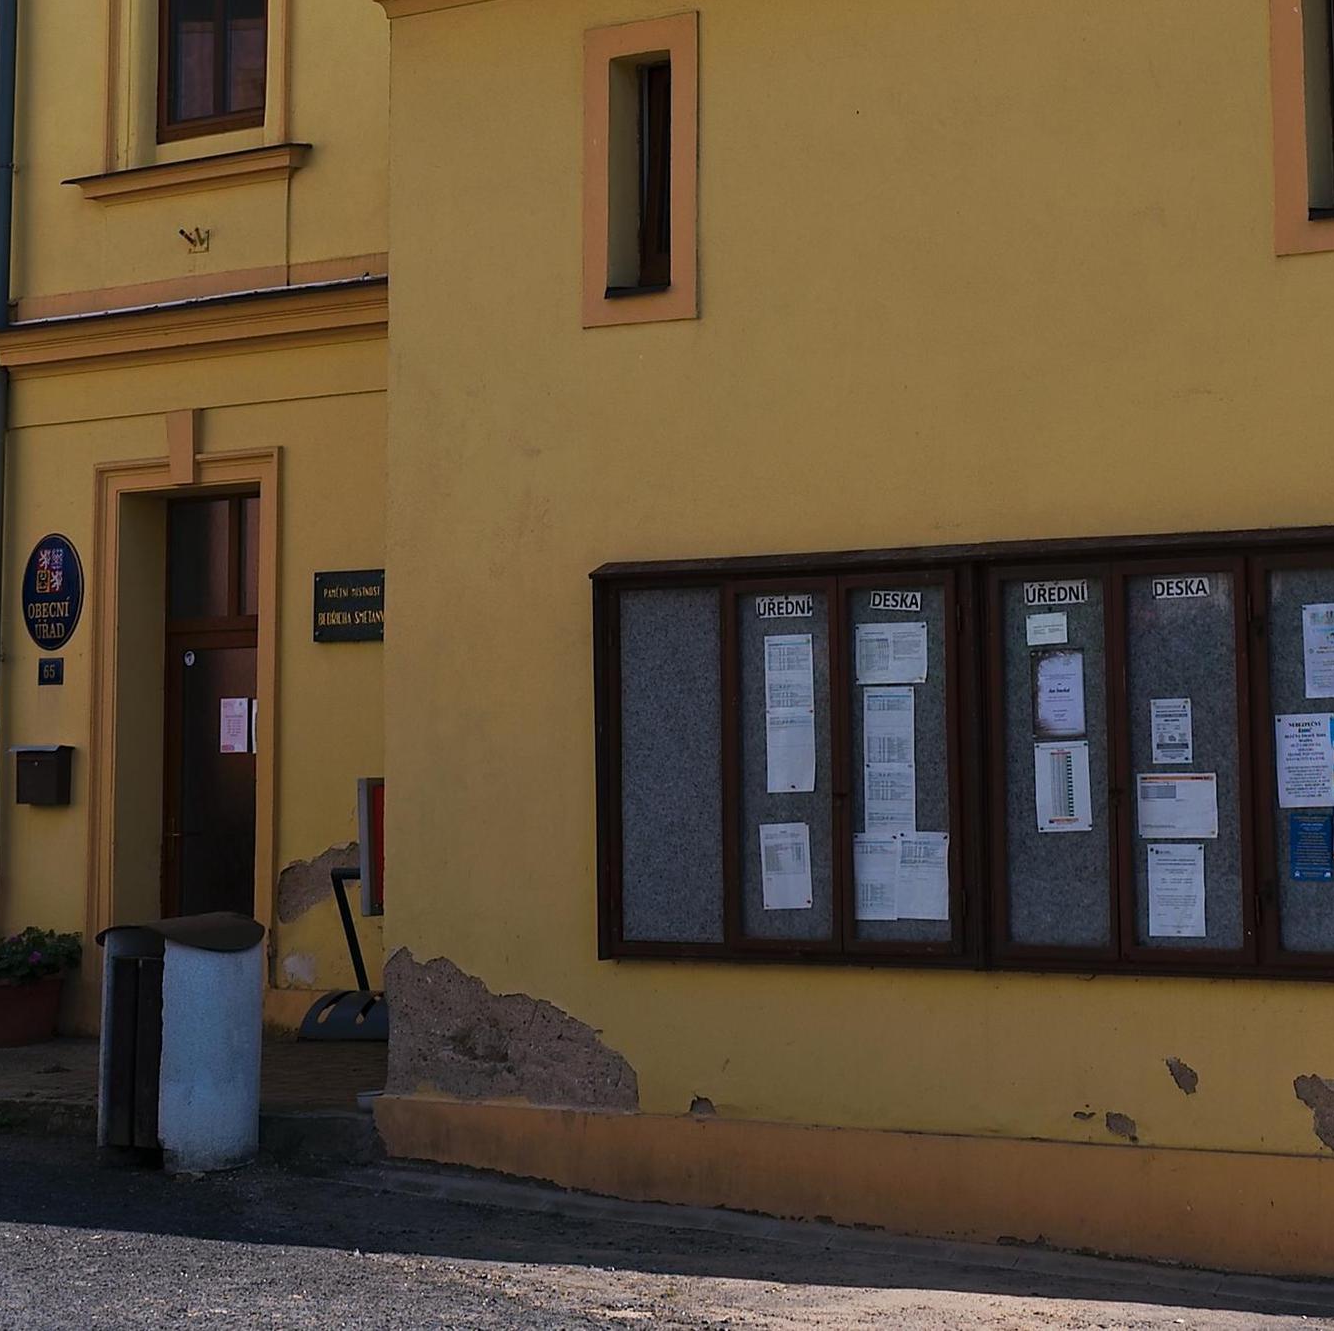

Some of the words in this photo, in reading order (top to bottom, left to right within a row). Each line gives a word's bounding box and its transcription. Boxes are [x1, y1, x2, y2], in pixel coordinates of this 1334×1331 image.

[1026, 581, 1085, 603] ÚŘEDNÍ
[1154, 579, 1208, 596] DESKA
[27, 596, 70, 619] OBECNÍ
[757, 596, 811, 616] ÚŘEDNÍ
[872, 592, 919, 609] DESKA
[35, 619, 65, 639] ÚŘAD
[43, 664, 56, 679] 65
